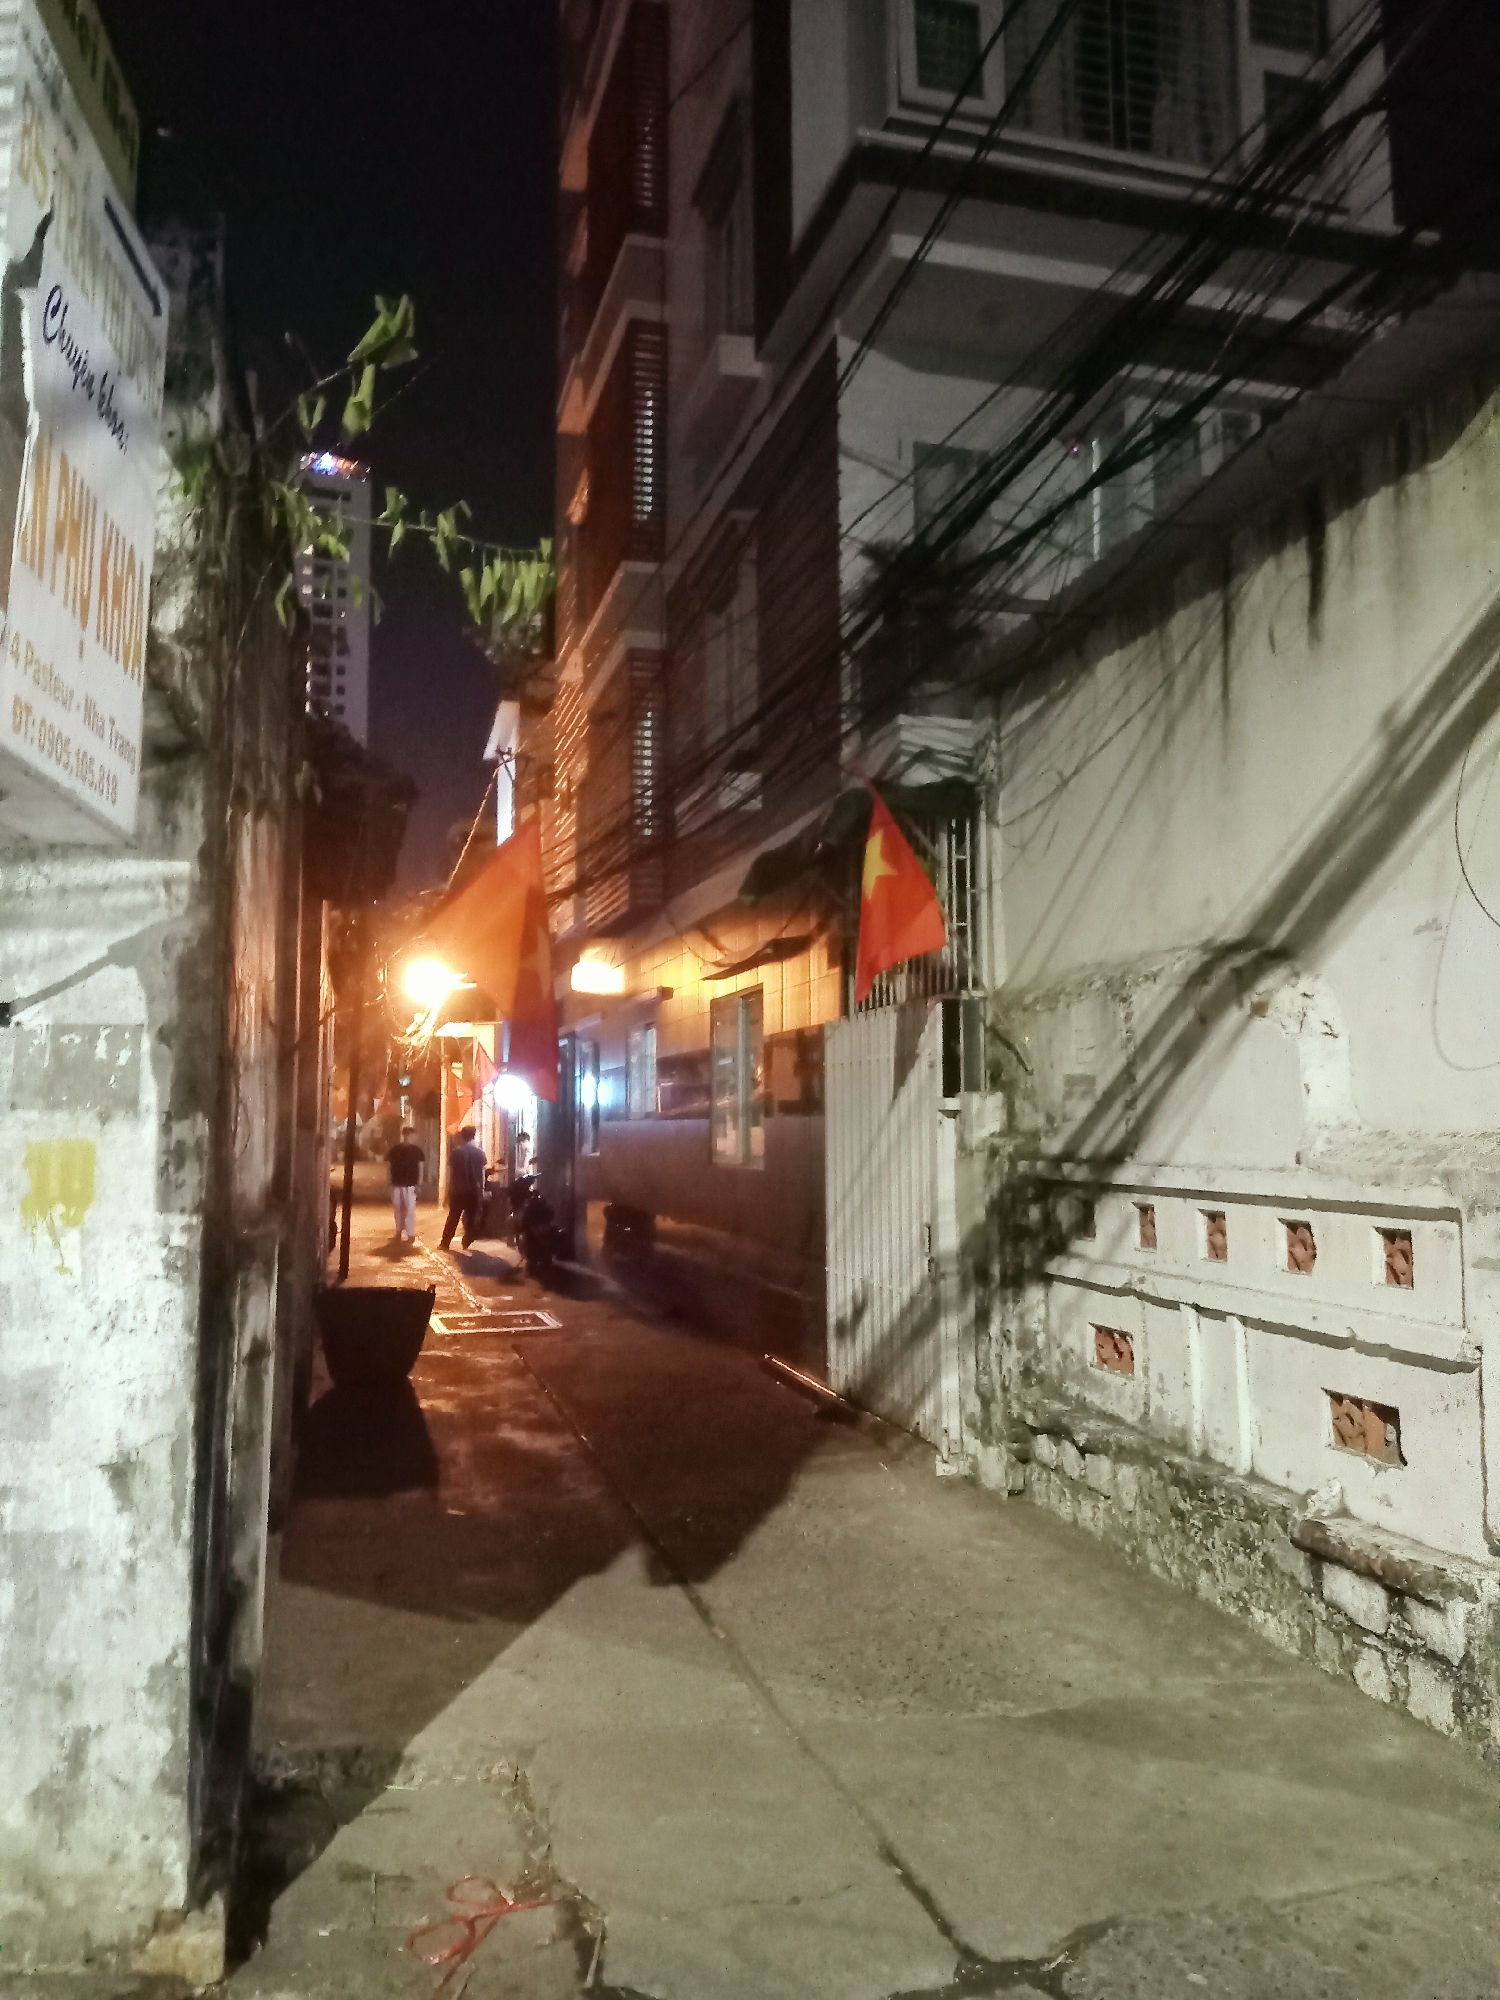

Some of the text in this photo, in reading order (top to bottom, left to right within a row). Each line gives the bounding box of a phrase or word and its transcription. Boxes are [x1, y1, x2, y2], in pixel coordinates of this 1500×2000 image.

[50, 450, 97, 661] PHỤ
[96, 509, 144, 687] KHOA
[23, 640, 75, 712] Pasteur
[83, 692, 105, 742] Nha
[108, 715, 136, 775] Trang
